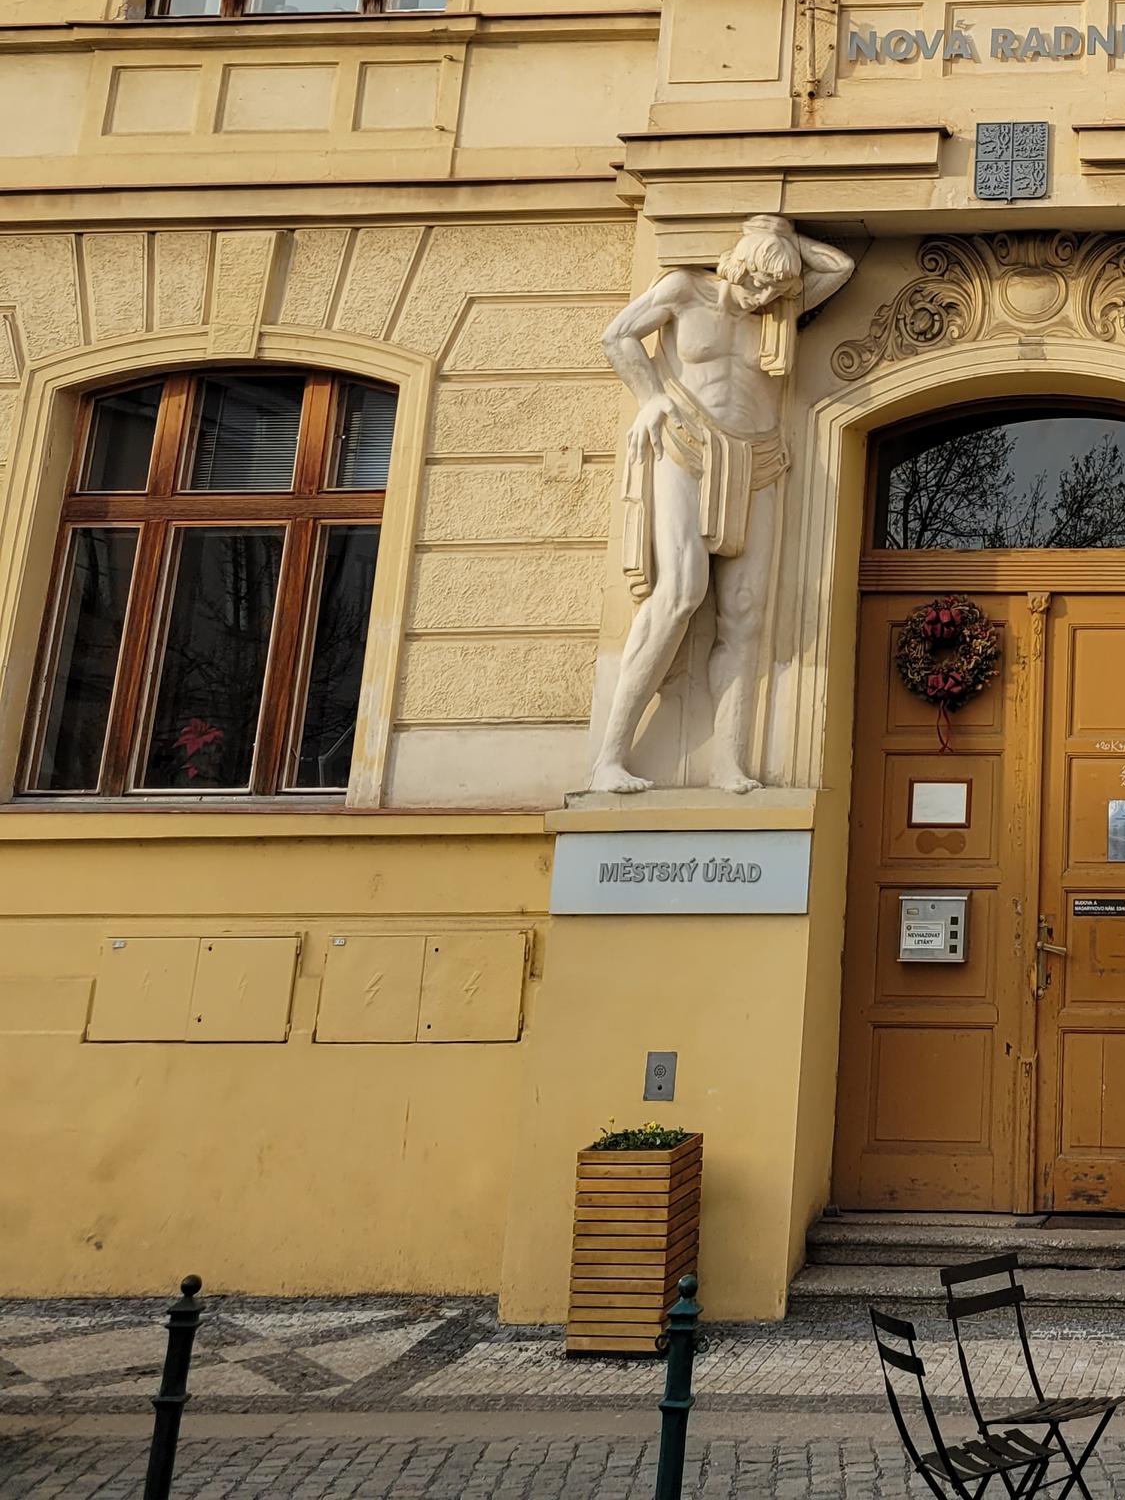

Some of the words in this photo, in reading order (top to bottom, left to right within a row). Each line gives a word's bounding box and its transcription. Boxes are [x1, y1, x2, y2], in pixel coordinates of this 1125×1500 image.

[847, 19, 974, 62] NOVÁ
[598, 857, 698, 883] MĚSTSKÝ
[702, 857, 762, 883] ÚŘAD
